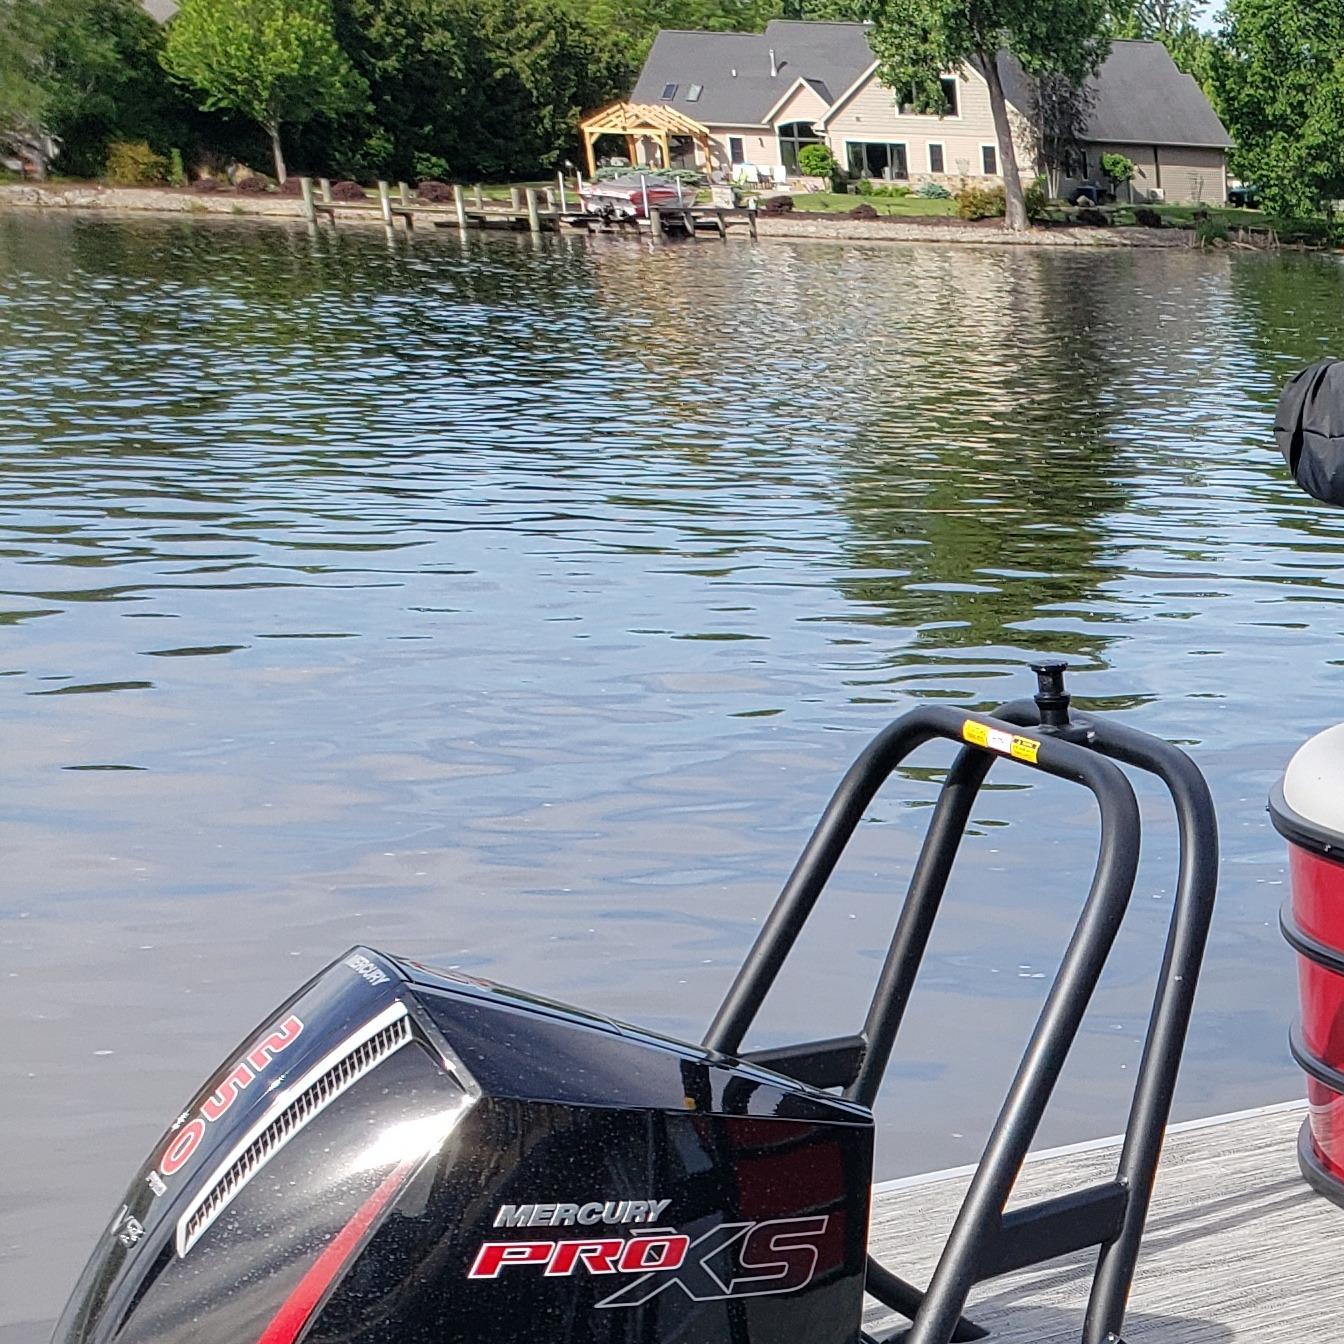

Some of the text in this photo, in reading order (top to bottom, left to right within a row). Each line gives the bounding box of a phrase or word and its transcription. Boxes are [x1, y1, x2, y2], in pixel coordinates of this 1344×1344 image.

[344, 953, 391, 986] MERCURY
[159, 1013, 304, 1177] 250
[492, 1199, 673, 1228] MERCURY
